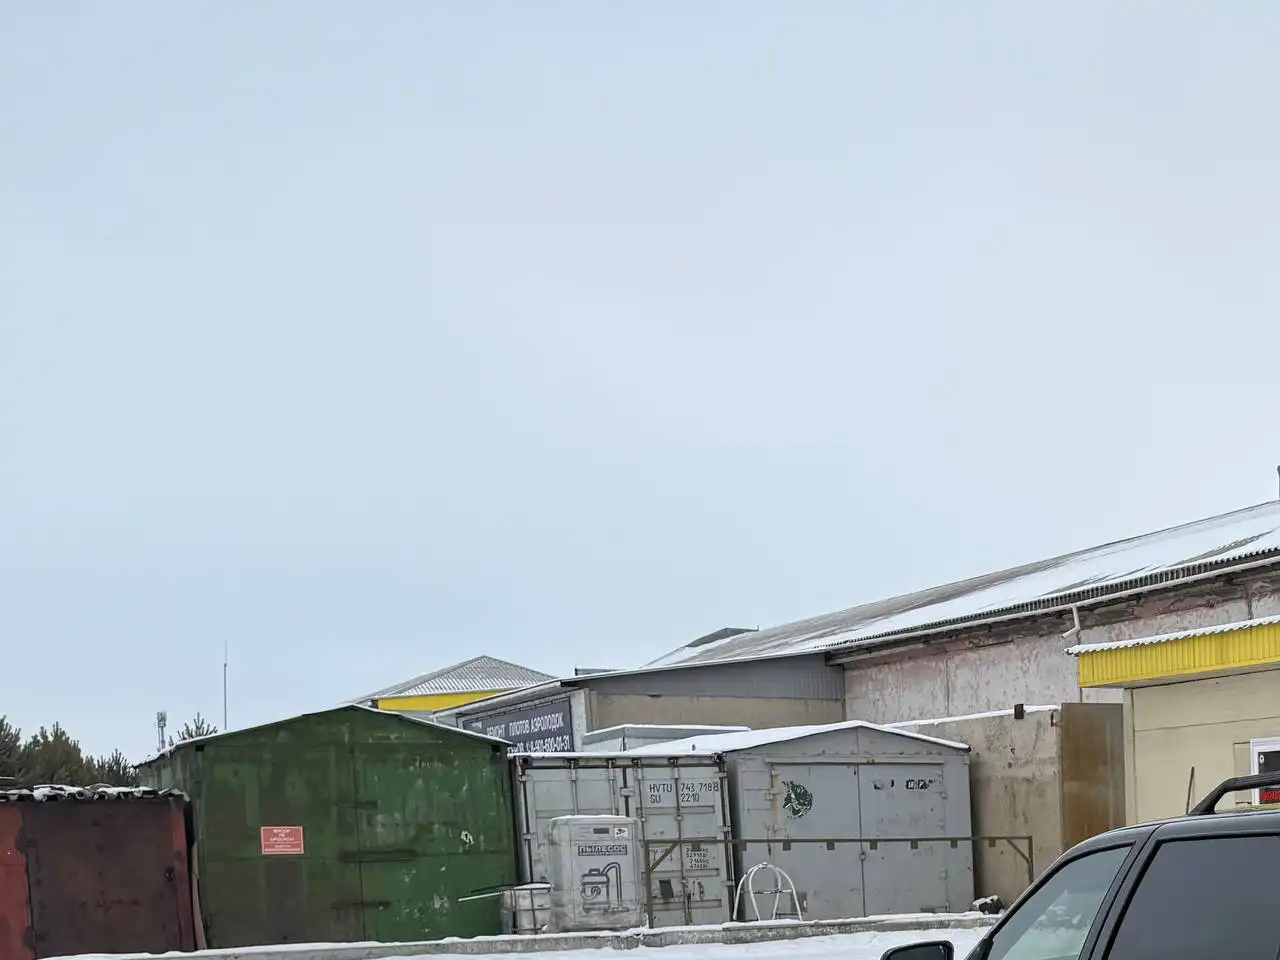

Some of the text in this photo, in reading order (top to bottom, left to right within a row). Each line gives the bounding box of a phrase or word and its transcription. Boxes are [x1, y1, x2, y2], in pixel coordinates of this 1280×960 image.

[508, 719, 530, 737] ПЛОТОВ
[649, 783, 672, 793] HVTU
[680, 783, 695, 793] 743
[650, 792, 700, 804] SU 2210
